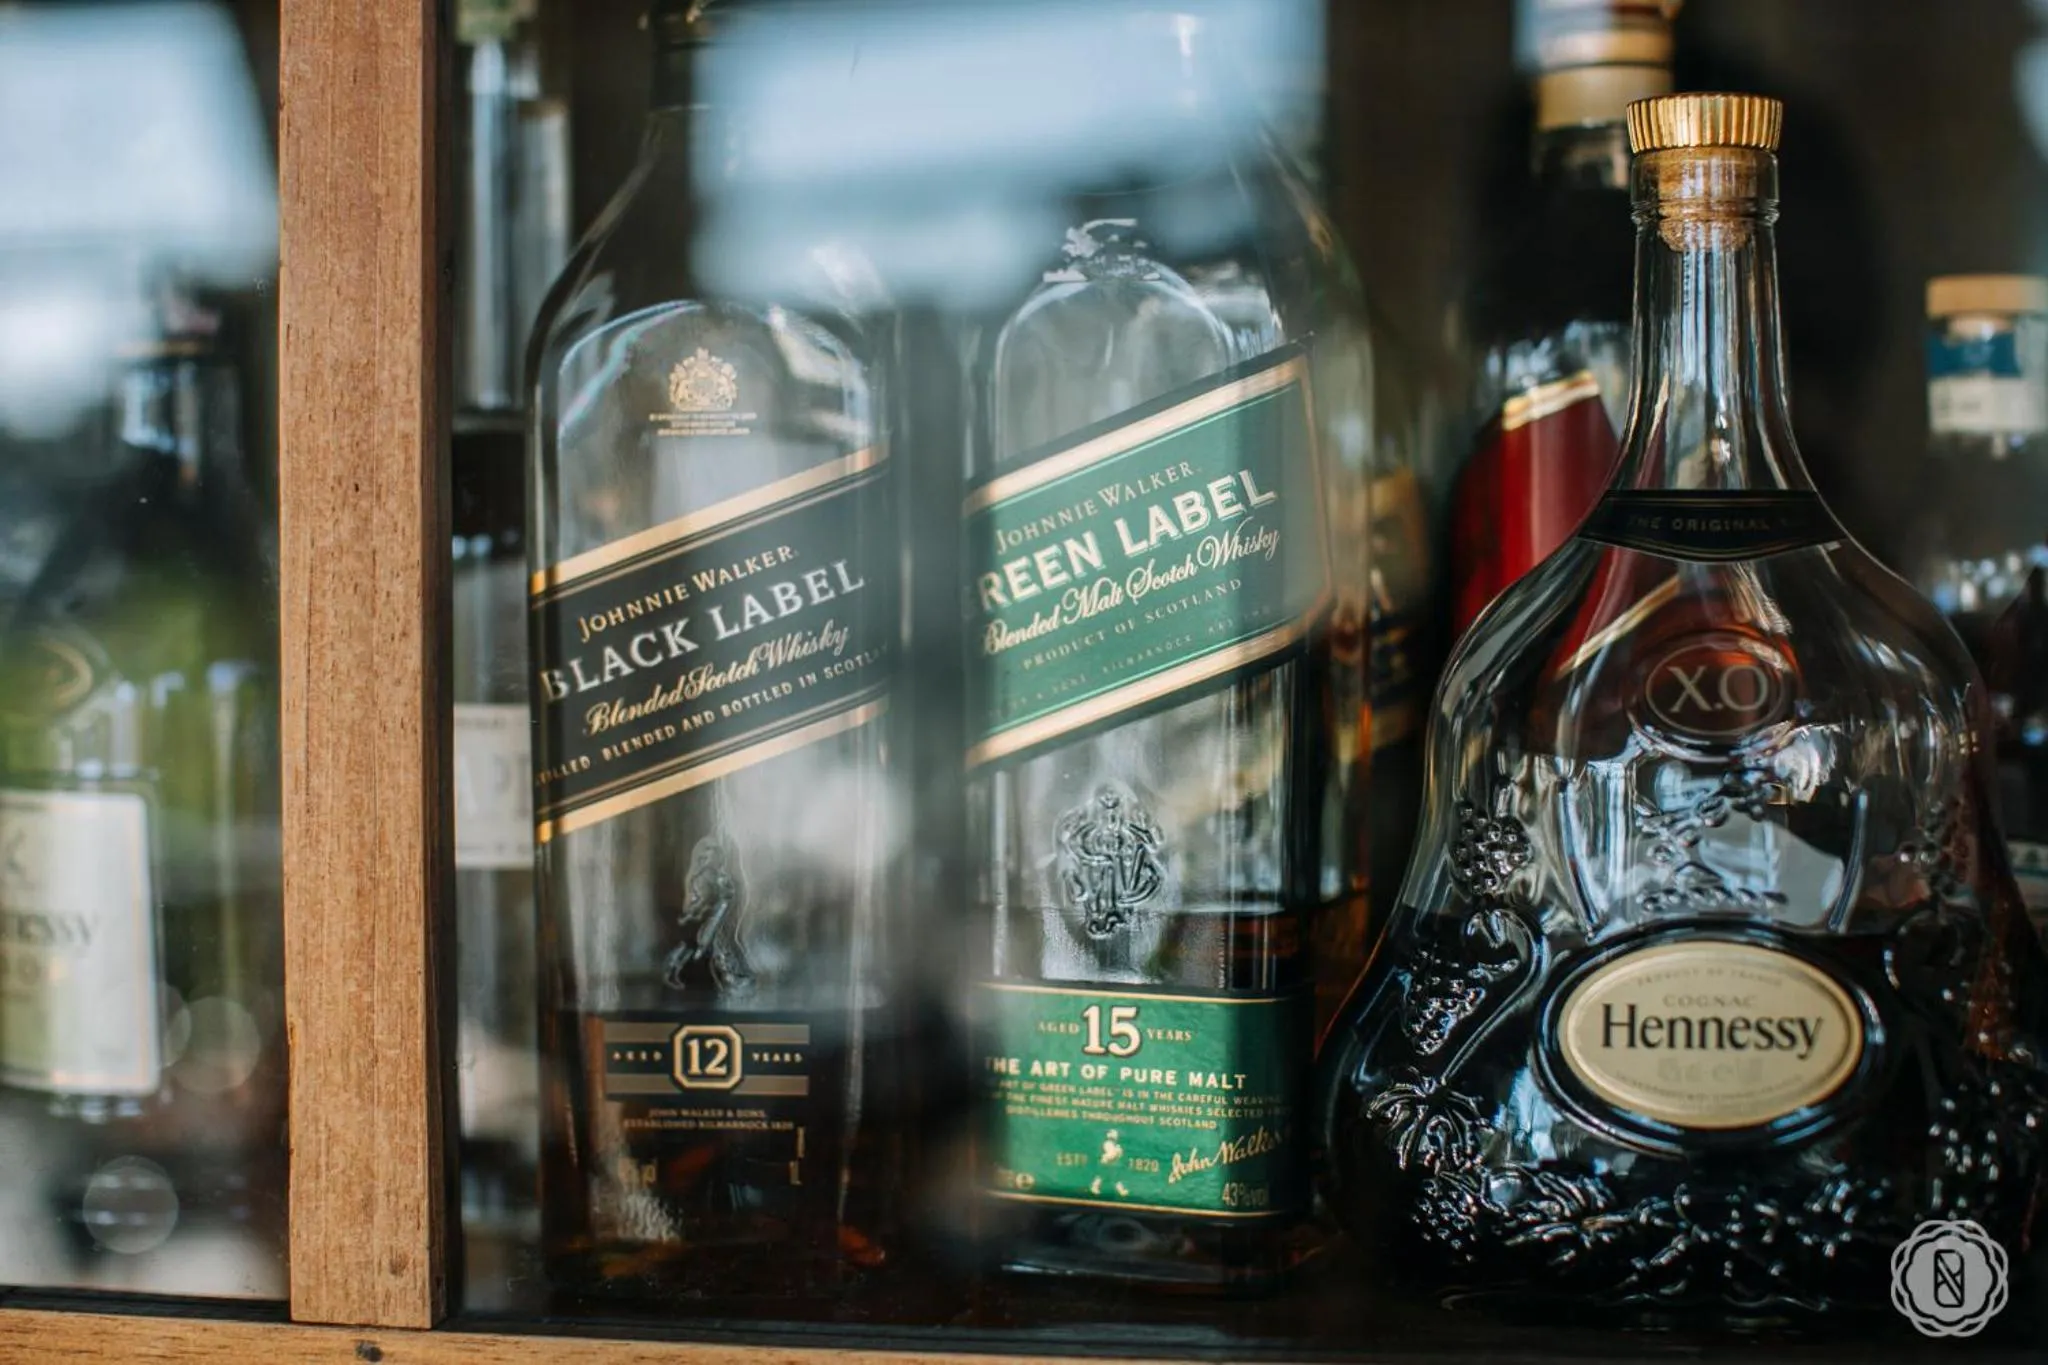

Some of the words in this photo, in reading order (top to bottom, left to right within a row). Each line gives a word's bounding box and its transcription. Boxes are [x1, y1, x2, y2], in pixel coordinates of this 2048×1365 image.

[996, 499, 1098, 554] JOHNNIE
[1098, 461, 1194, 507] WALKER
[1115, 470, 1277, 556] LABEL
[1671, 517, 1771, 532] ORIGINAL
[577, 583, 690, 644] JOHNNIE
[691, 545, 795, 593] WALKER
[983, 605, 1061, 656] Blended
[1061, 577, 1123, 624] Malt
[1125, 556, 1197, 605] Scotch
[1196, 516, 1280, 569] Whisky
[539, 617, 700, 701] BLACK
[706, 558, 865, 642] LABEL
[1023, 631, 1106, 670] PRODUCT
[1114, 619, 1136, 635] OF
[1144, 578, 1242, 625] SCOTLAND
[583, 674, 687, 737] Blended
[684, 646, 760, 700] Scotch
[757, 619, 849, 671] Whisky
[1667, 664, 1768, 713] X.O
[601, 724, 676, 761] BLENDED
[681, 710, 716, 732] AND
[720, 680, 793, 718] BOTTLED
[798, 671, 818, 689] IN
[1663, 994, 1756, 1009] COGNAC
[687, 1037, 729, 1076] 12
[1038, 1021, 1080, 1035] AGED
[1083, 1005, 1142, 1057] 15
[1146, 1028, 1192, 1041] YEARS
[1601, 1003, 1823, 1061] Hennessy
[1030, 1060, 1071, 1078] ART
[1080, 1063, 1109, 1080] OF
[1119, 1067, 1178, 1086] PURE
[1188, 1071, 1247, 1089] MALT
[1159, 1116, 1218, 1131] SCOTLAND
[1128, 1157, 1160, 1174] 1820
